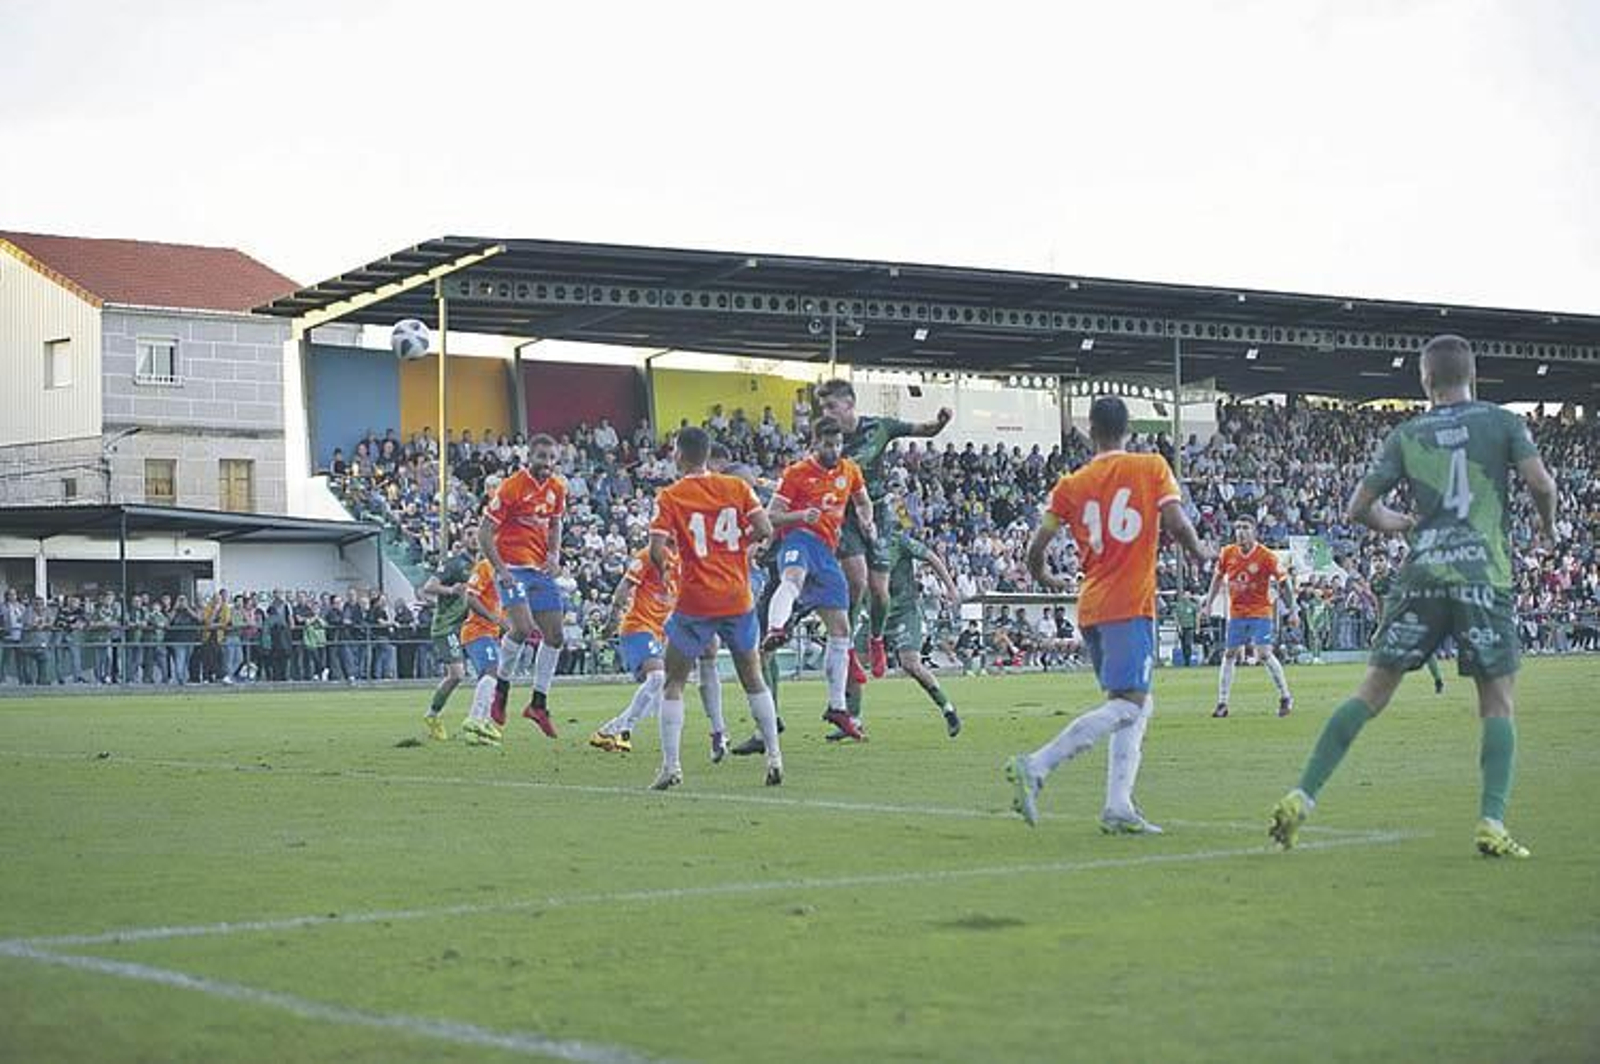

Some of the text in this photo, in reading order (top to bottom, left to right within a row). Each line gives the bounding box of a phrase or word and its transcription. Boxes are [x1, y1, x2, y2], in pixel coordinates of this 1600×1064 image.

[1443, 448, 1475, 519] 4
[688, 507, 742, 558] 14
[1082, 487, 1143, 555] 16
